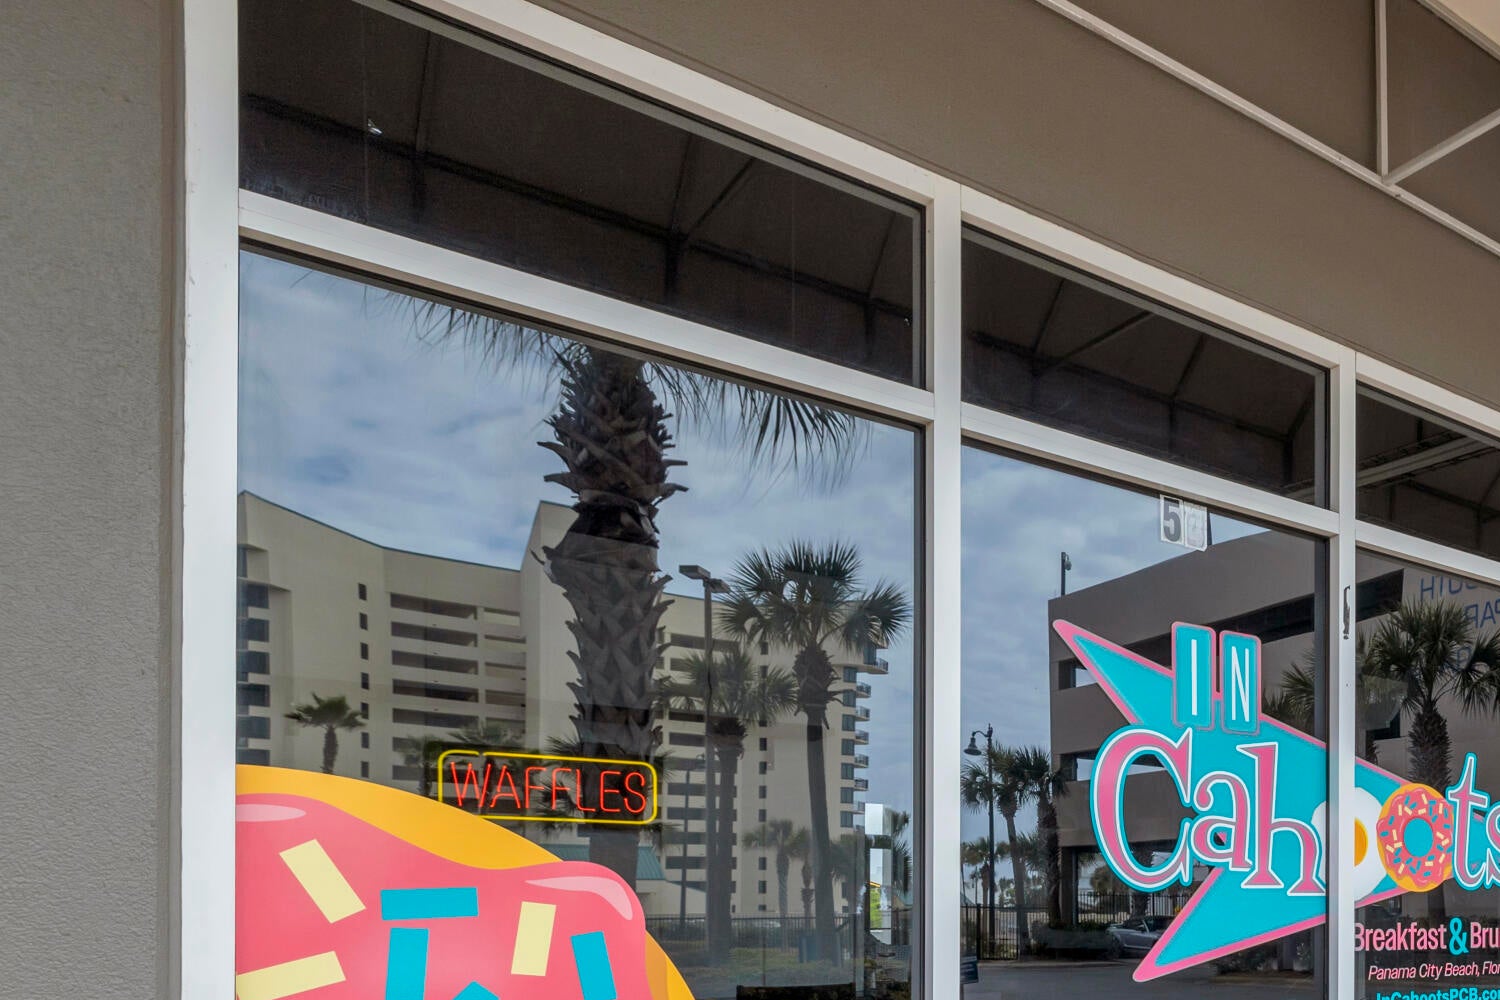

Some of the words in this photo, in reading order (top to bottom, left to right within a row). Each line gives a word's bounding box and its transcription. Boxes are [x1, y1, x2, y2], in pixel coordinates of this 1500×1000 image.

[1189, 636, 1252, 724] IN
[450, 761, 647, 813] WAFFLES
[1354, 922, 1447, 951] Breakfast
[1449, 917, 1469, 955] &
[1368, 965, 1416, 981] Panama
[1419, 963, 1443, 981] City
[1444, 961, 1480, 977] Beach,
